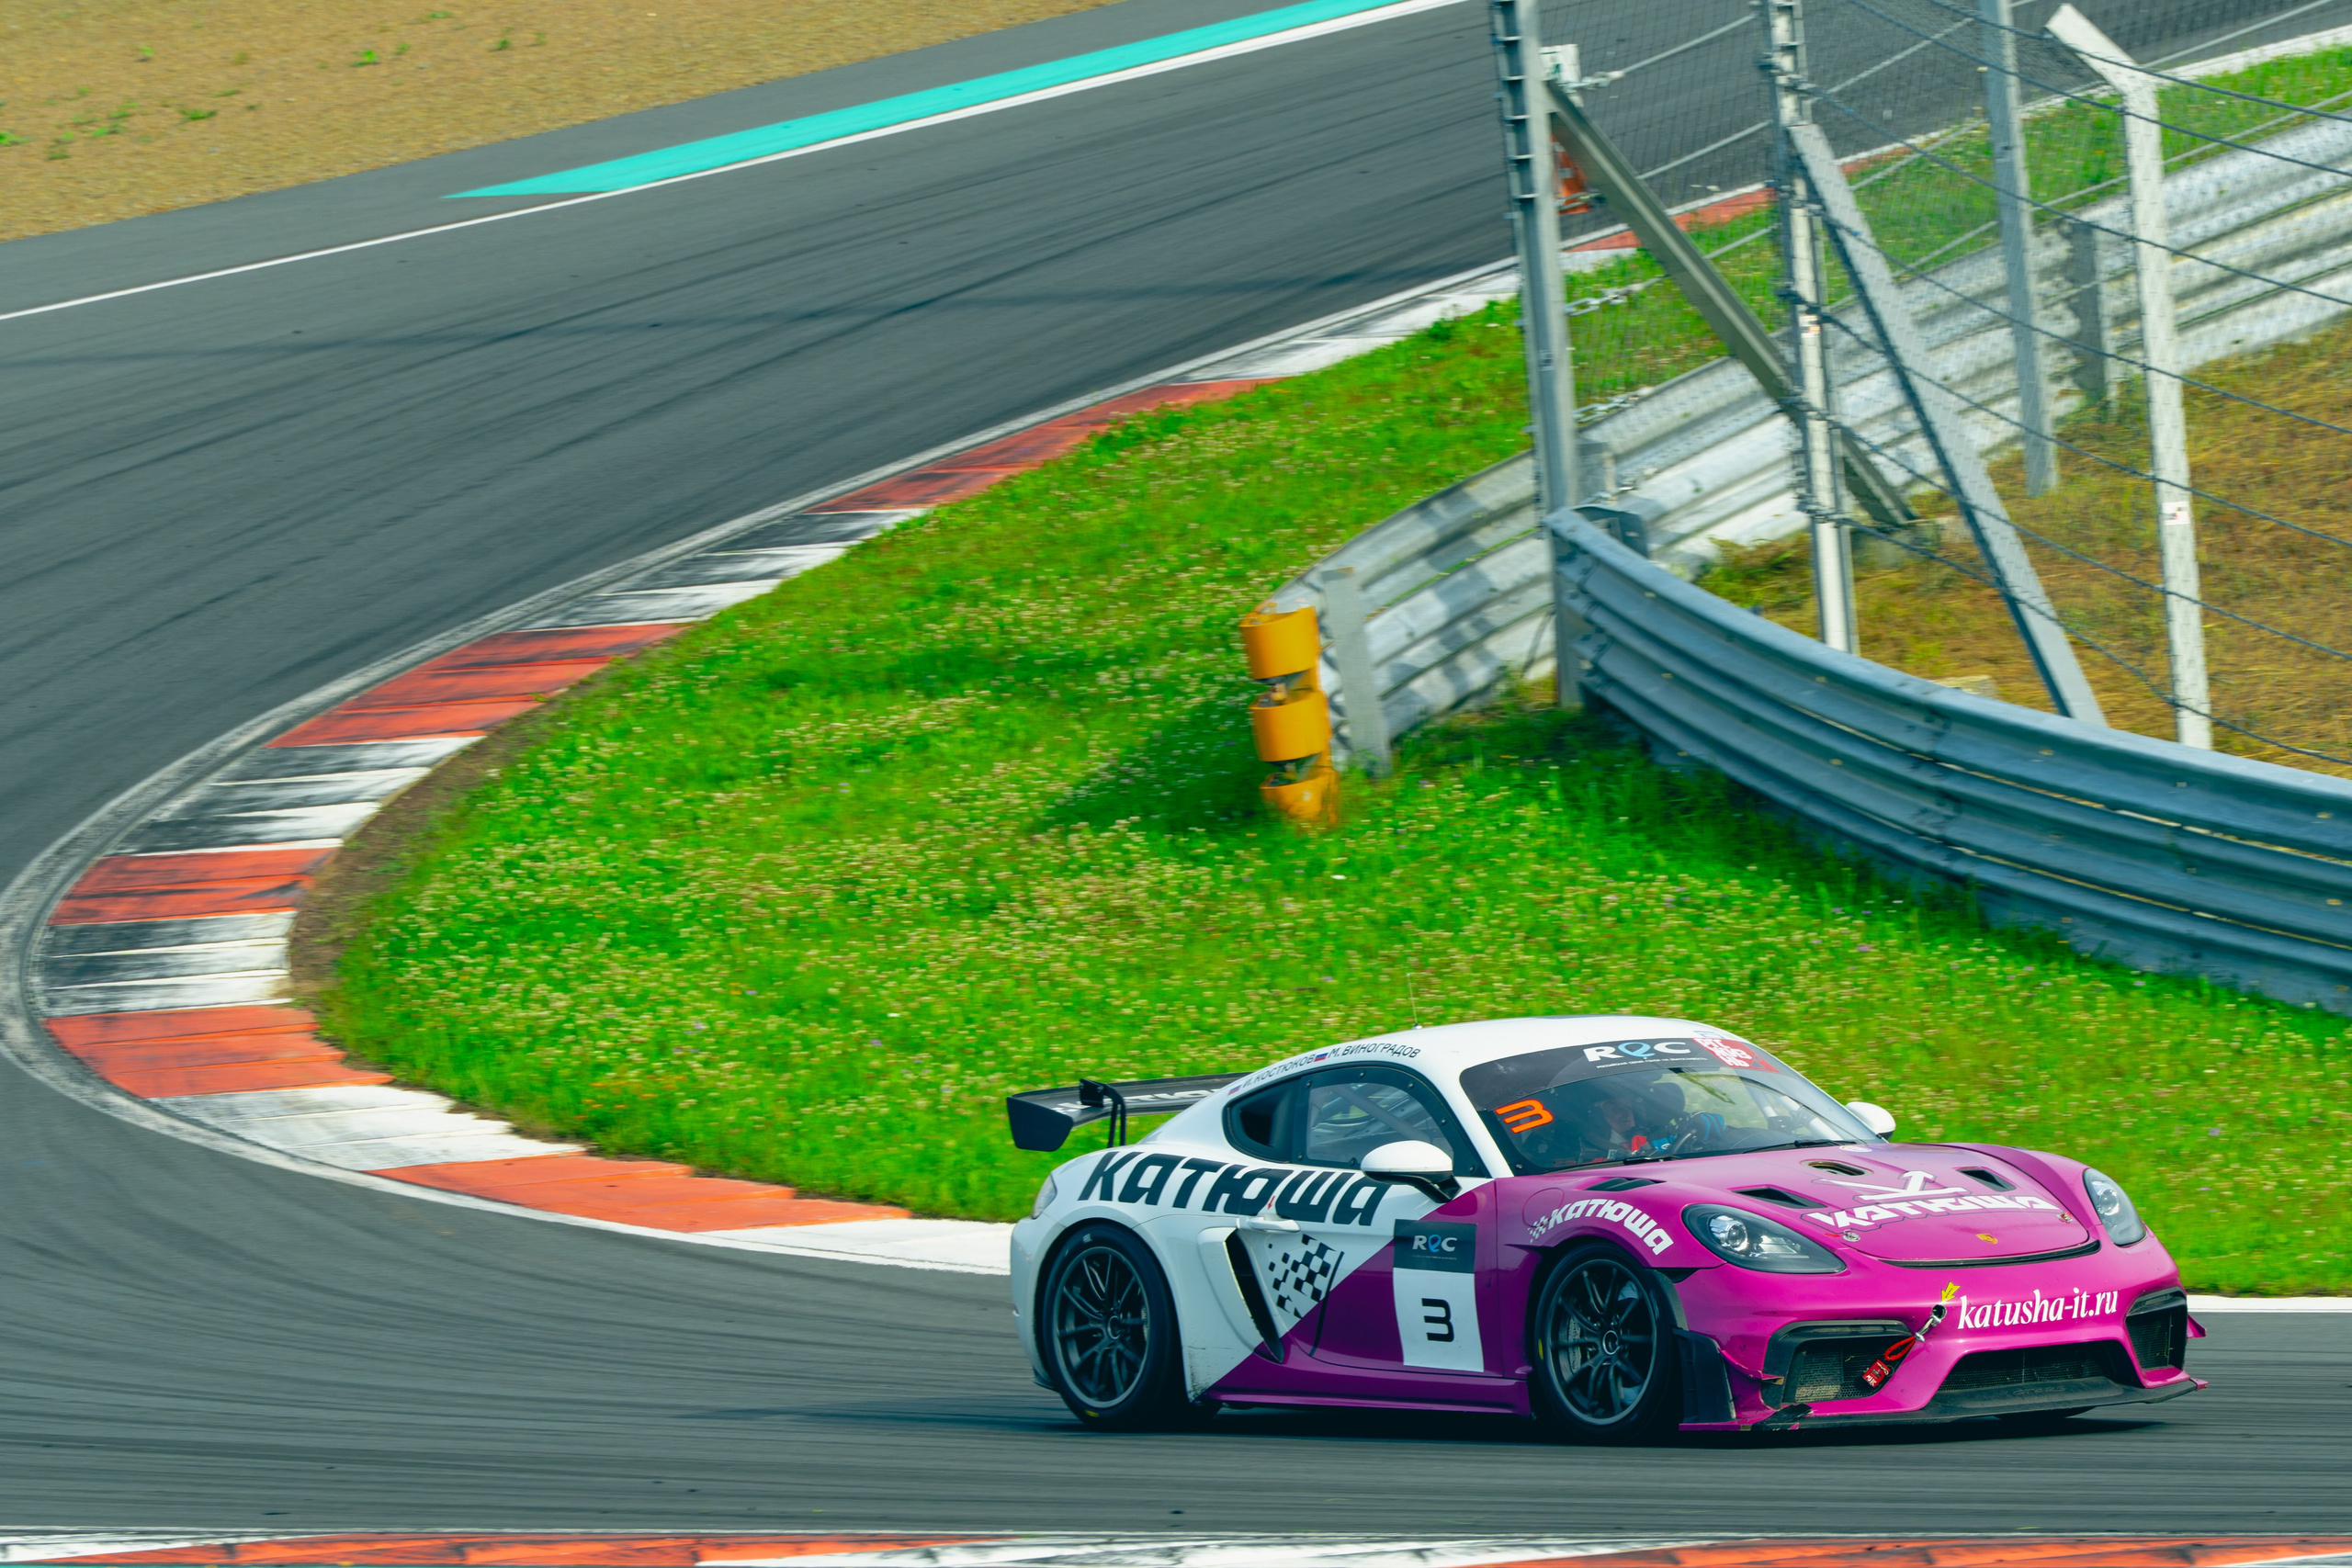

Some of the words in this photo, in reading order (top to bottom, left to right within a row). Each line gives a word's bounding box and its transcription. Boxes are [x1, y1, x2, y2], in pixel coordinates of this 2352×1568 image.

[1341, 1043, 1421, 1058] ВИНОГРАДОВ
[1254, 1054, 1316, 1083] КОСТЮКОВ
[1495, 1099, 1554, 1134] 3
[1421, 1298, 1454, 1342] 3
[1958, 1288, 2119, 1329] katusha-it.ru
